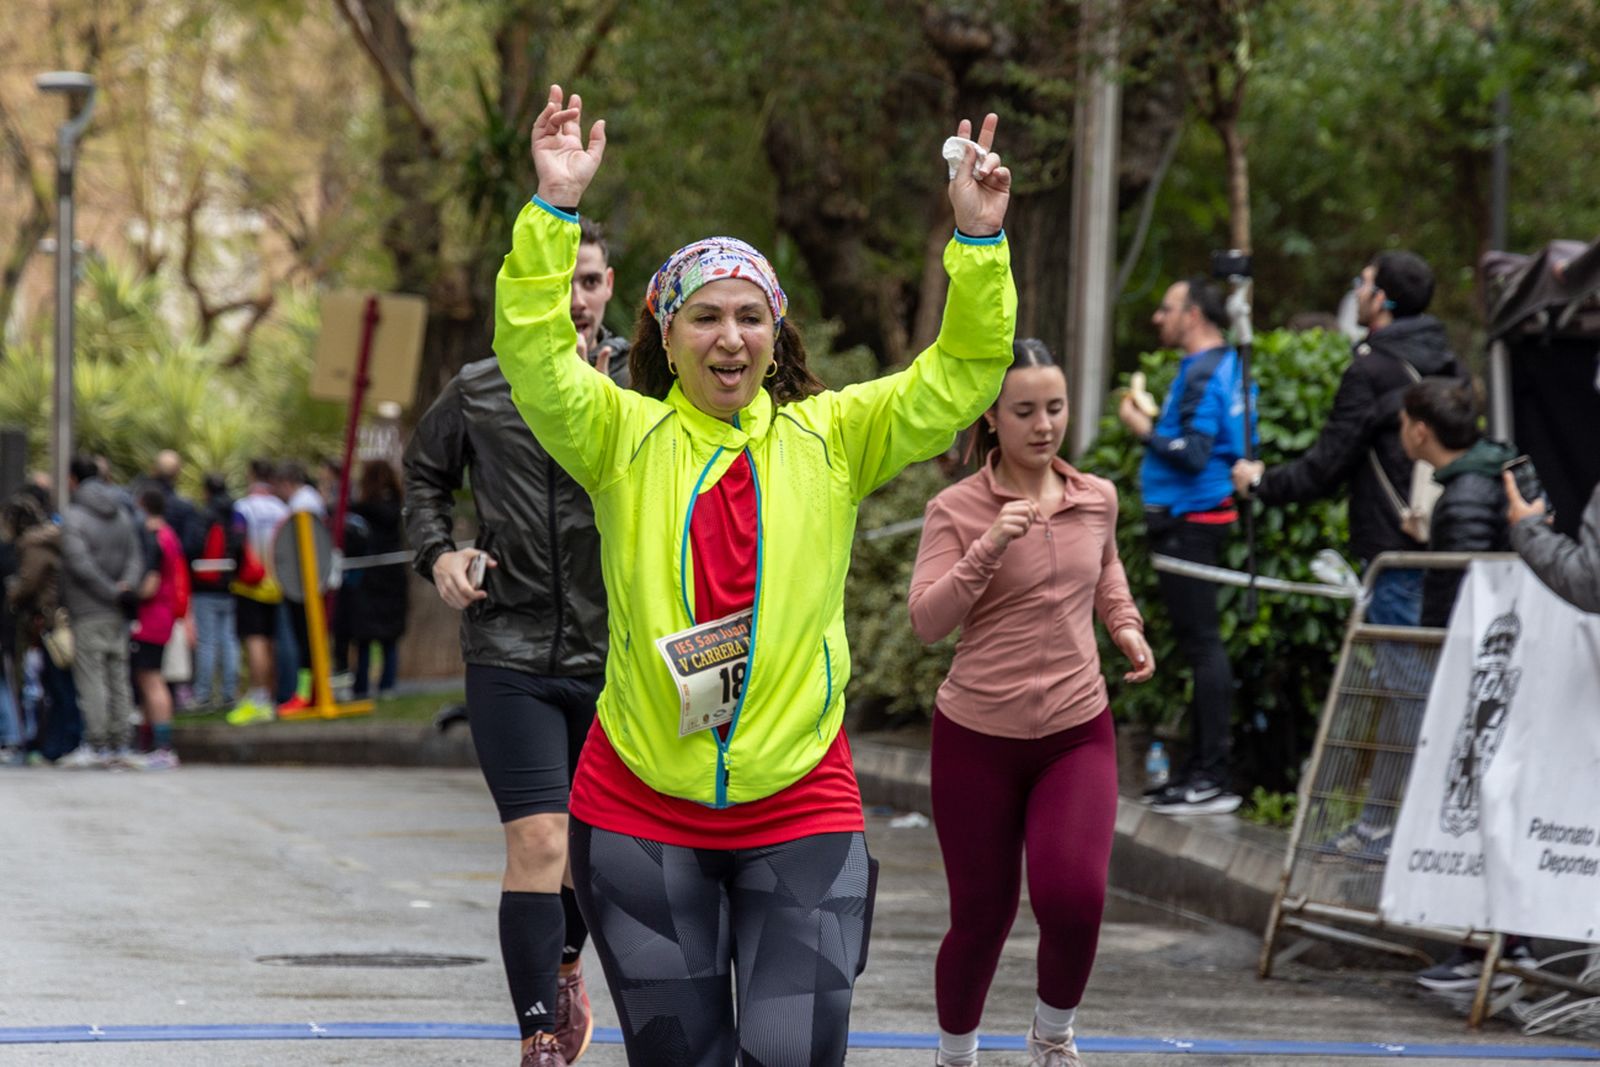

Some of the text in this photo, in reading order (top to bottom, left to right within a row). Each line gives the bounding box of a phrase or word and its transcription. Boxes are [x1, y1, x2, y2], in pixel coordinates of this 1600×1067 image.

[673, 622, 748, 655] IES San Juan
[678, 658, 689, 672] V
[691, 640, 745, 669] CARRERA
[1526, 816, 1595, 847] Patronato
[1538, 848, 1599, 879] Deportes
